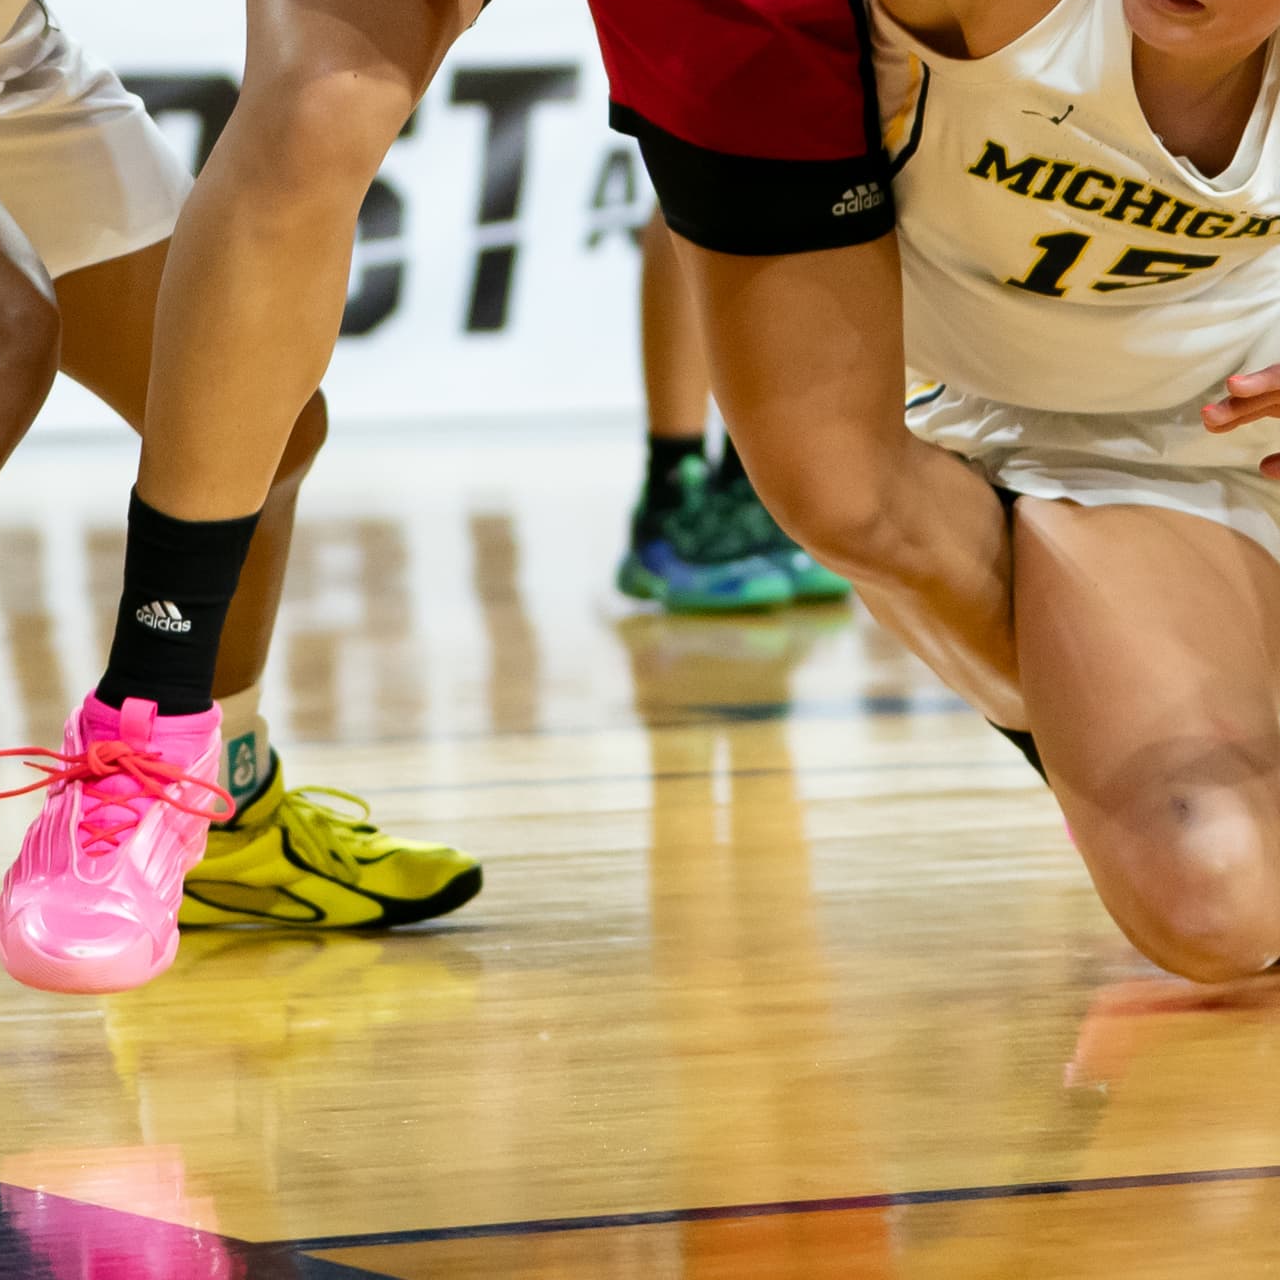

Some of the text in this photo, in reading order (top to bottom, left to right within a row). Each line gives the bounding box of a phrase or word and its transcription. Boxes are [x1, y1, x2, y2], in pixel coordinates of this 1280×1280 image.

[832, 191, 884, 217] adida
[1004, 231, 1221, 298] 15
[136, 608, 192, 633] adidas
